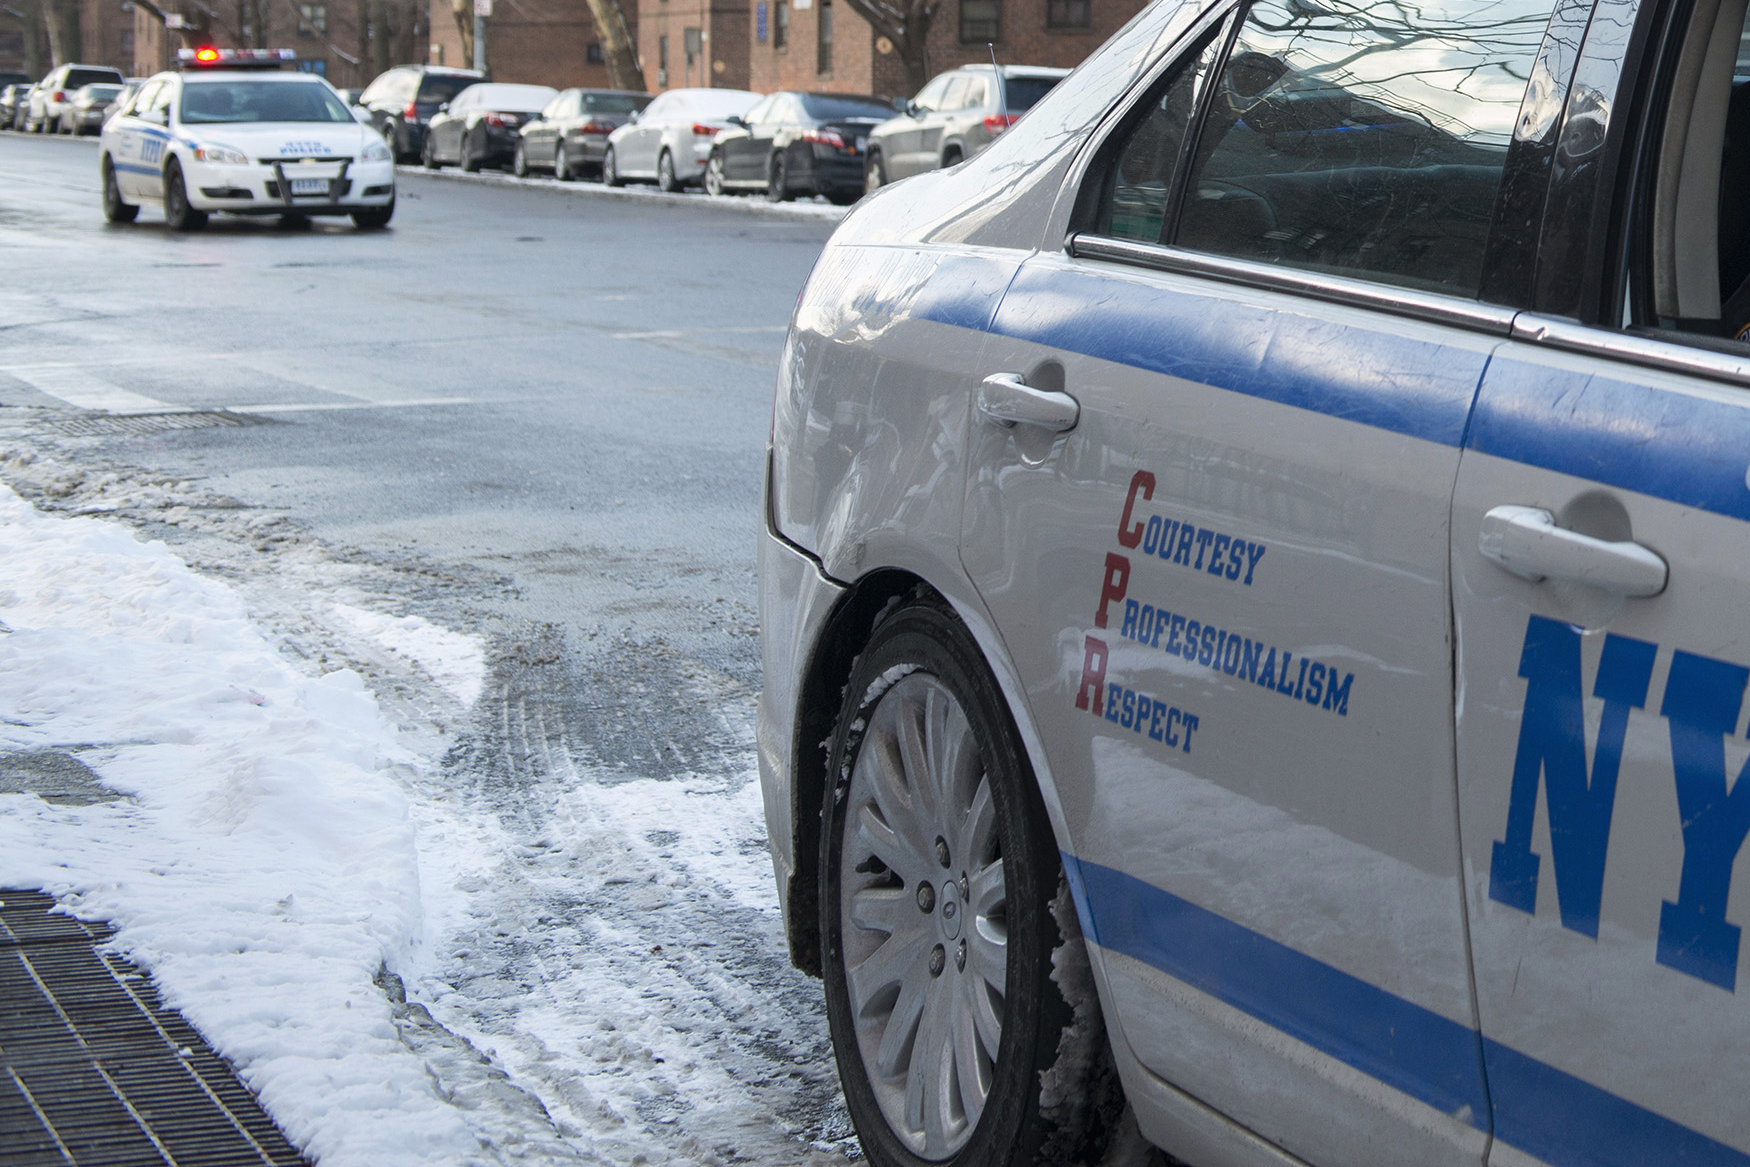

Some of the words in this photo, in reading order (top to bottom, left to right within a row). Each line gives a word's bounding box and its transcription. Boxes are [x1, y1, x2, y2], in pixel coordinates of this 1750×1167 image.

[1117, 469, 1266, 585] COURTESY
[1094, 551, 1355, 716] PROFESSIONALISM
[1075, 635, 1199, 754] RESPECT
